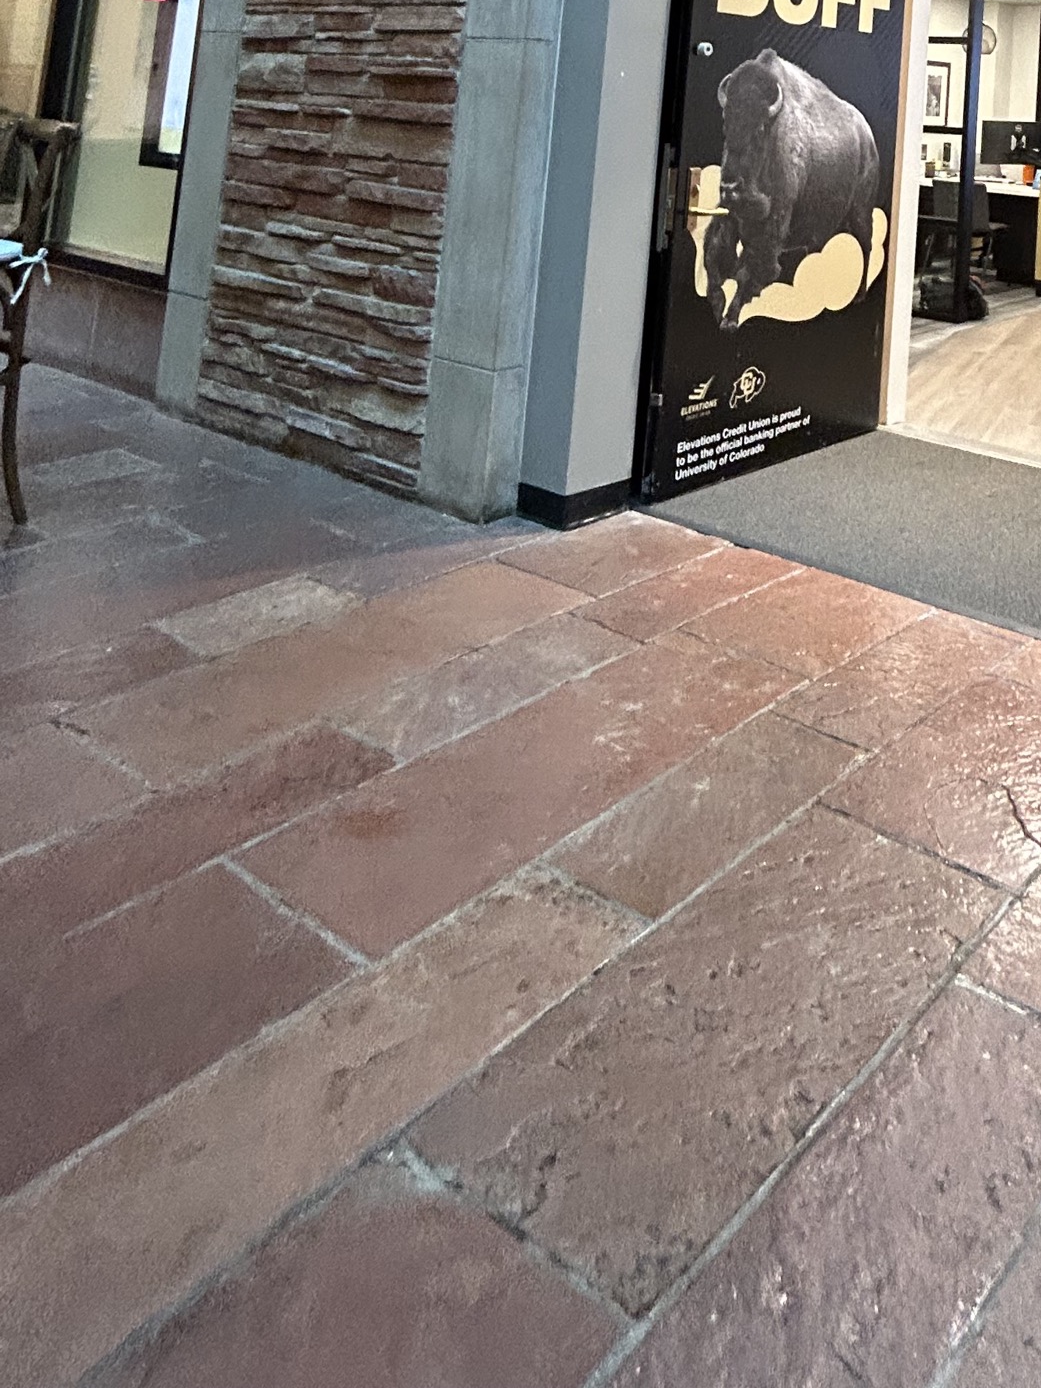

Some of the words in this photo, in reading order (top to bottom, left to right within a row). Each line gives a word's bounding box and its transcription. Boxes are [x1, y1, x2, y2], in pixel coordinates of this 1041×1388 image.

[681, 398, 718, 417] ELEVATIONS
[676, 457, 686, 468] to
[687, 453, 699, 464] be
[700, 448, 714, 459] the
[715, 437, 743, 455] official
[744, 428, 775, 444] banking
[775, 420, 802, 438] partner
[802, 414, 811, 426] of
[677, 432, 721, 454] Elevations
[722, 423, 747, 439] Credit
[748, 417, 771, 431] Union
[771, 414, 779, 424] is
[780, 406, 802, 423] proud
[674, 459, 718, 481] University
[719, 453, 728, 466] of
[729, 443, 765, 463] Colorado
